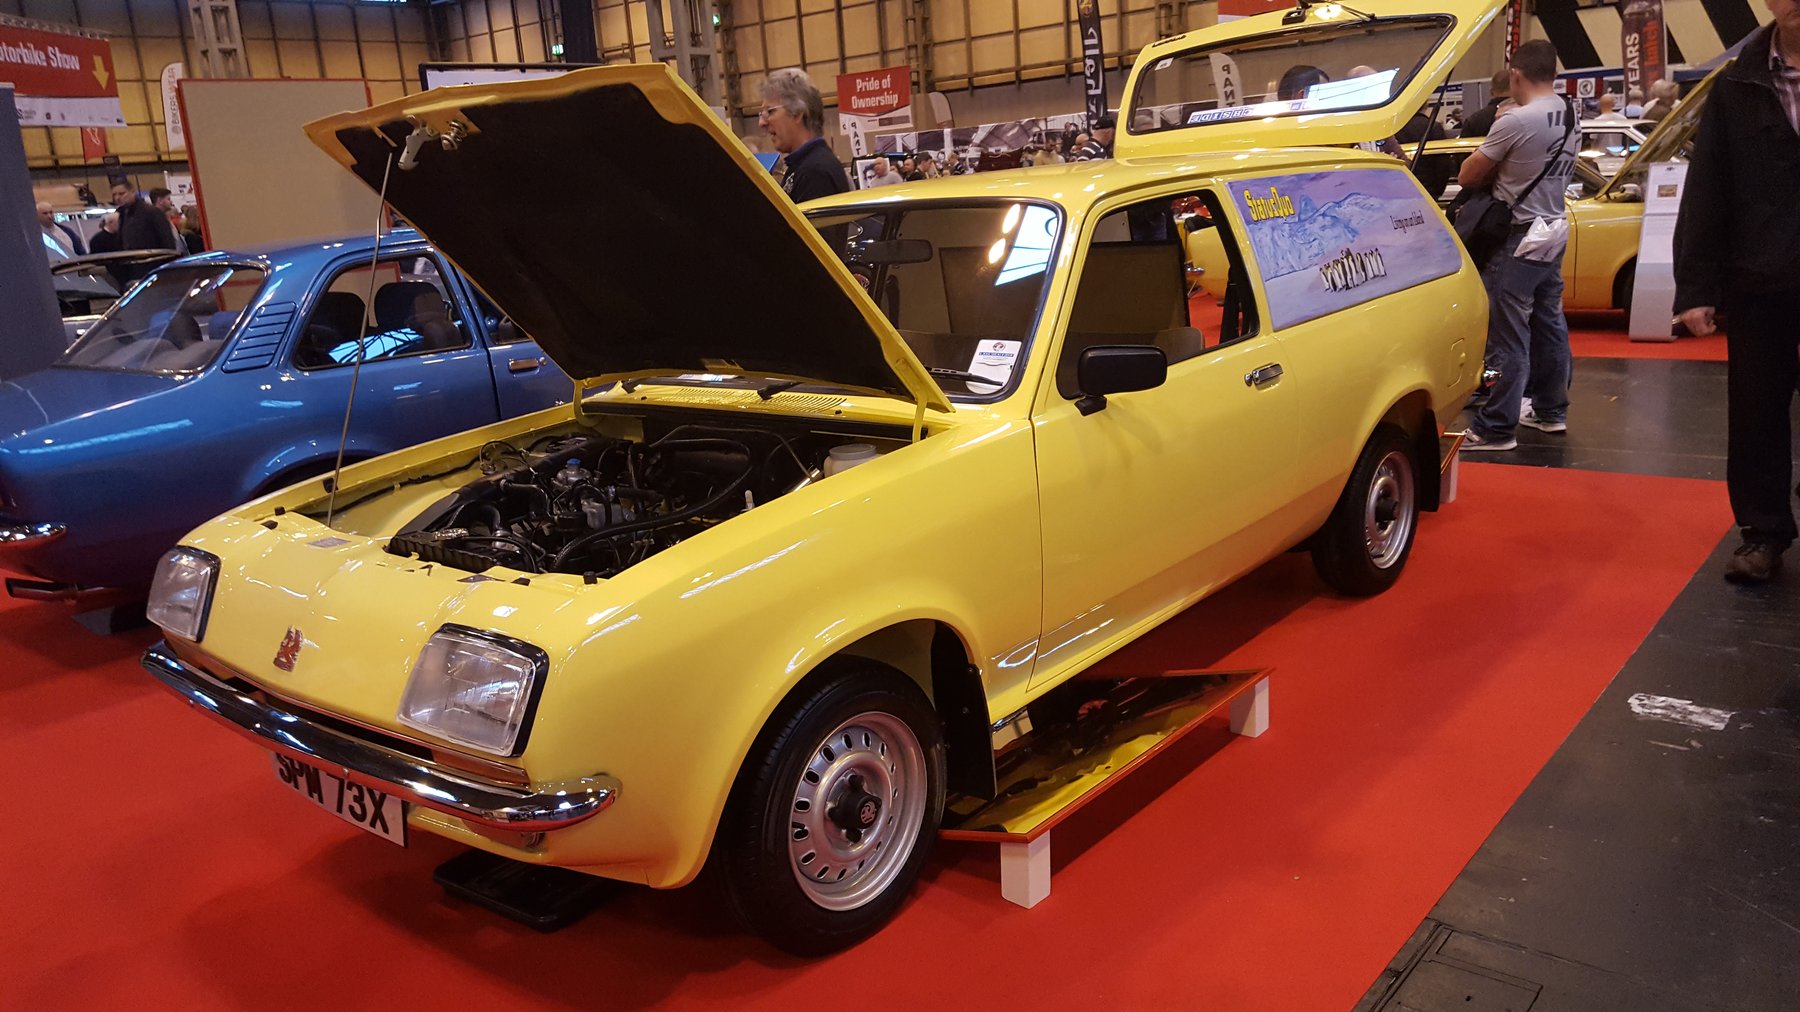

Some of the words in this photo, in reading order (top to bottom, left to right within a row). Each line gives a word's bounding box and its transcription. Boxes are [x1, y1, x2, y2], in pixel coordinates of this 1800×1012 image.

[47, 45, 80, 71] Show
[855, 77, 880, 92] Pride
[881, 74, 892, 89] of
[851, 91, 899, 108] Ownership
[275, 751, 324, 804] SPM
[326, 771, 389, 835] 73X
